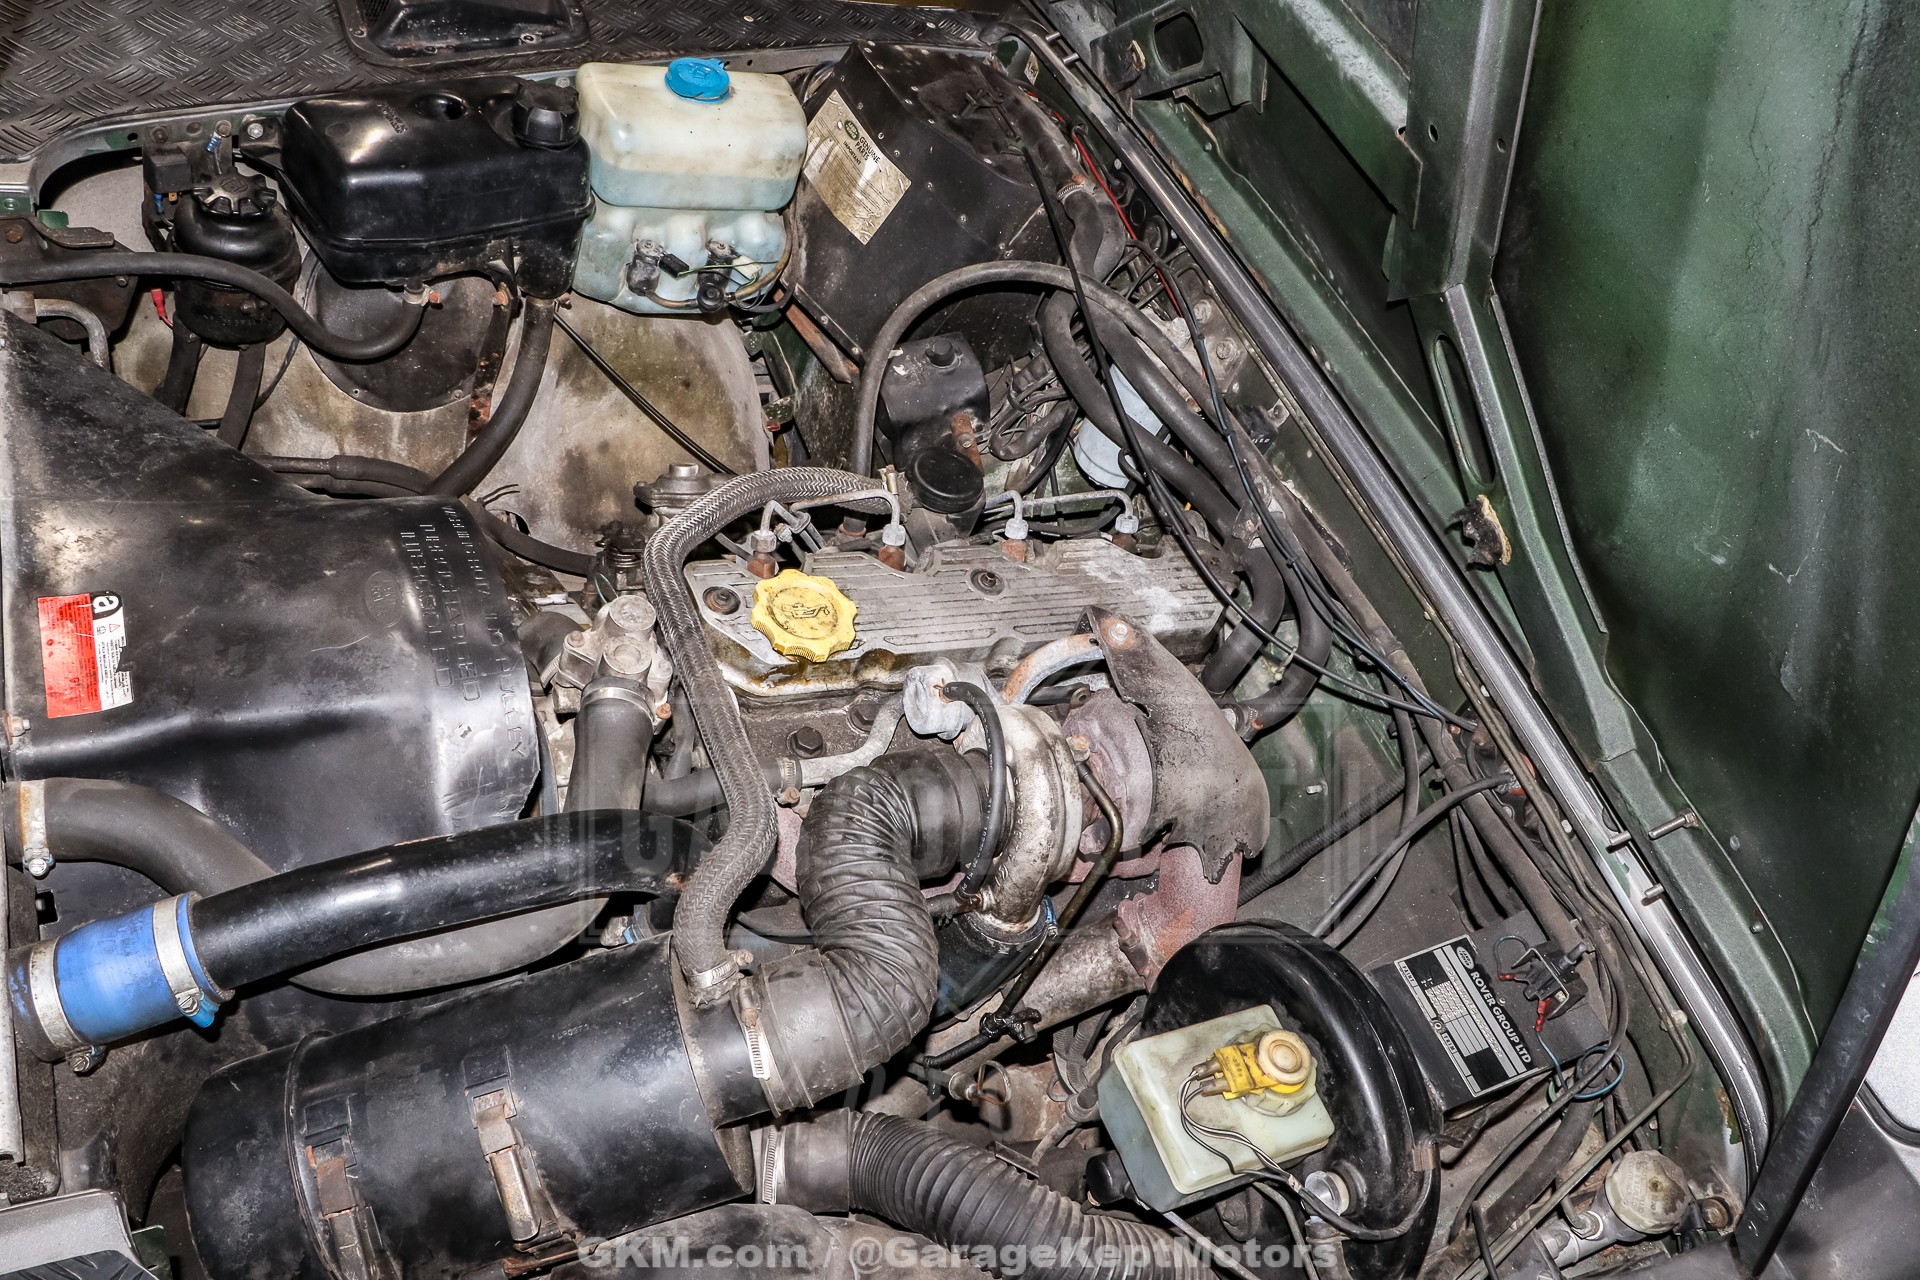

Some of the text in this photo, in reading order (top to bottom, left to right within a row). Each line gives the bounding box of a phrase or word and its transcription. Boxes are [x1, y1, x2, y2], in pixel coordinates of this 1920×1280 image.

[843, 140, 862, 166] IMPORTANT
[854, 142, 870, 161] PARTS
[859, 136, 881, 164] GENUINE
[1401, 964, 1415, 987] PAINT
[1470, 971, 1497, 1006] ROVER
[1492, 1006, 1521, 1044] GROUP
[1513, 1042, 1532, 1063] LTD
[1442, 1033, 1456, 1053] TRIM
